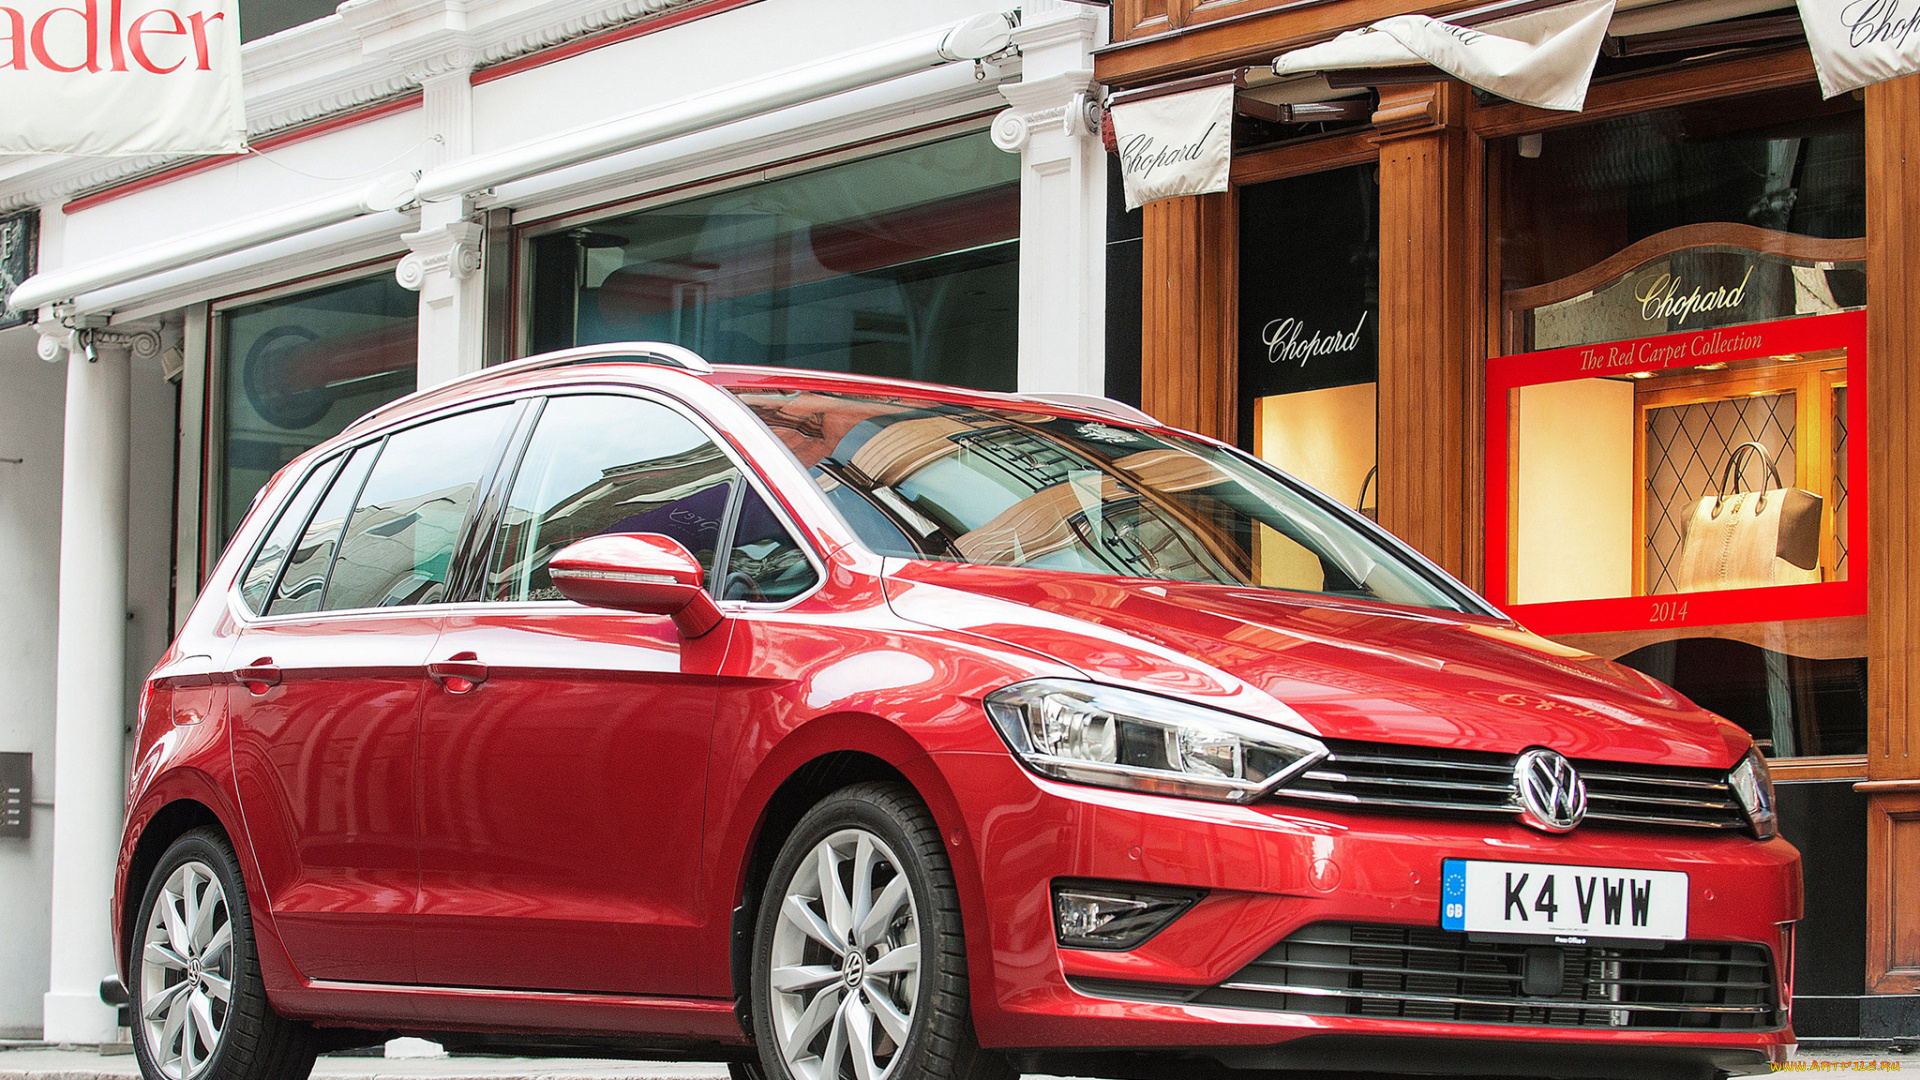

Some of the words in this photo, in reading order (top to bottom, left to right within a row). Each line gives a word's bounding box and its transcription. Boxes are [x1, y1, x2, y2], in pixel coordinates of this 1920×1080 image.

[0, 0, 224, 74] adler
[1635, 265, 1754, 325] Chopard
[1262, 310, 1368, 368] Chopard
[1580, 348, 1603, 371] The
[1607, 343, 1636, 369] Red
[1638, 342, 1687, 367] Carpet
[1691, 331, 1762, 357] Collection
[1649, 601, 1688, 622] 2014
[1446, 903, 1463, 918] GB
[1504, 872, 1558, 922] K4
[1574, 875, 1651, 926] VWW
